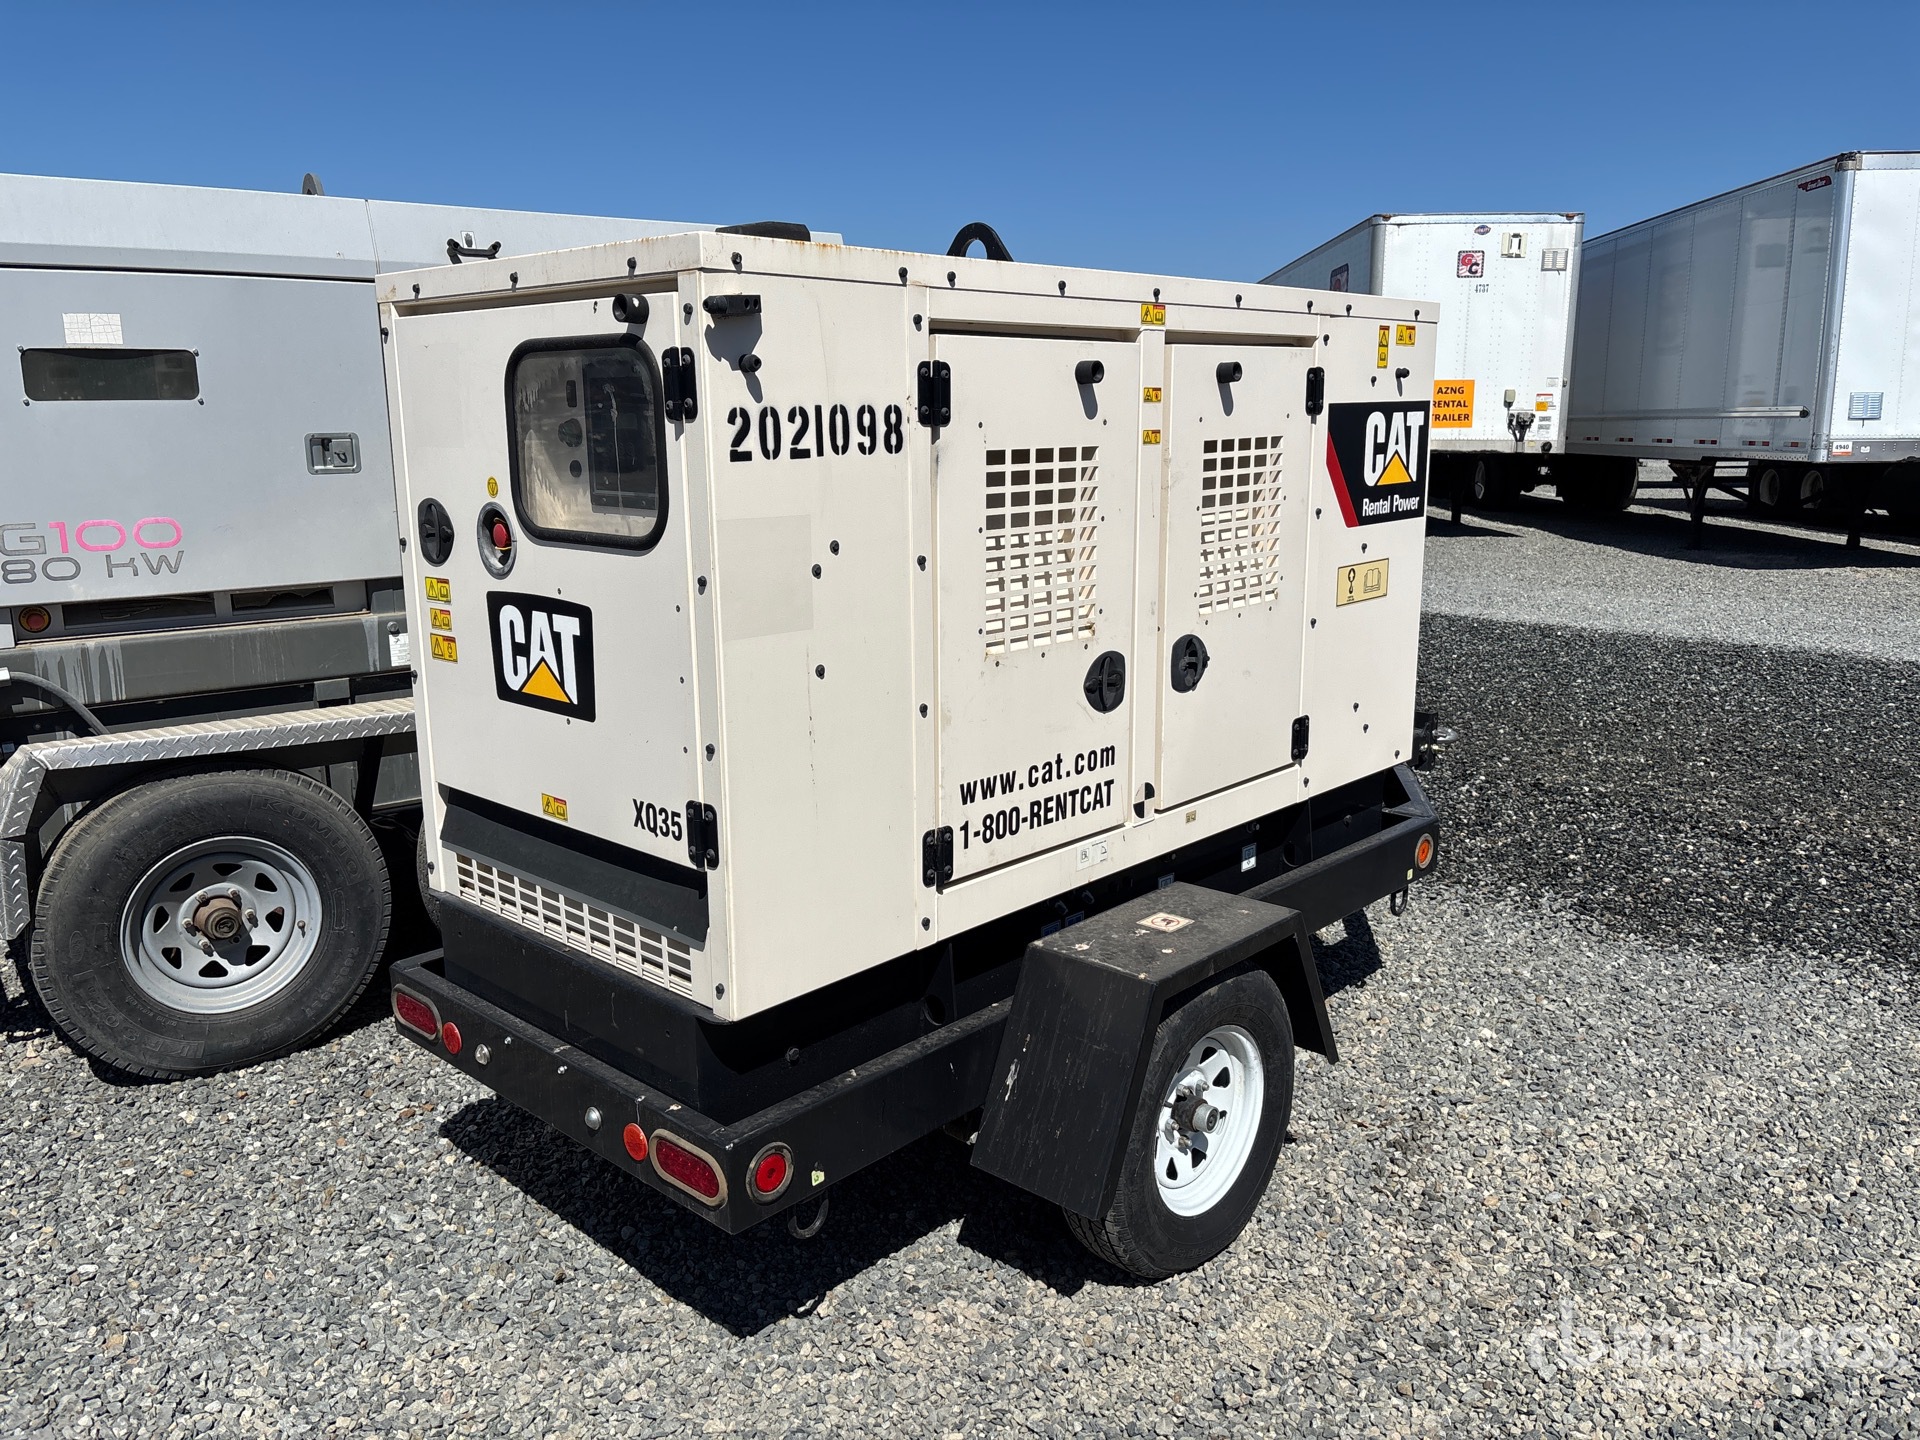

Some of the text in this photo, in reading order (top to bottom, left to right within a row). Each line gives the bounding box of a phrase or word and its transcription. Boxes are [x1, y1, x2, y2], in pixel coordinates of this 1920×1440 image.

[1437, 387, 1465, 395] AZNG
[727, 403, 904, 463] 2021098
[1364, 411, 1425, 487] CAT
[1362, 494, 1420, 517] Rental Power
[1, 556, 82, 585] 80
[499, 604, 581, 706] CAT
[960, 744, 1116, 806] www.cat.com
[261, 800, 361, 879] KUMHO
[632, 798, 683, 842] XQ35
[960, 778, 1115, 850] 1-800-RENTCAT
